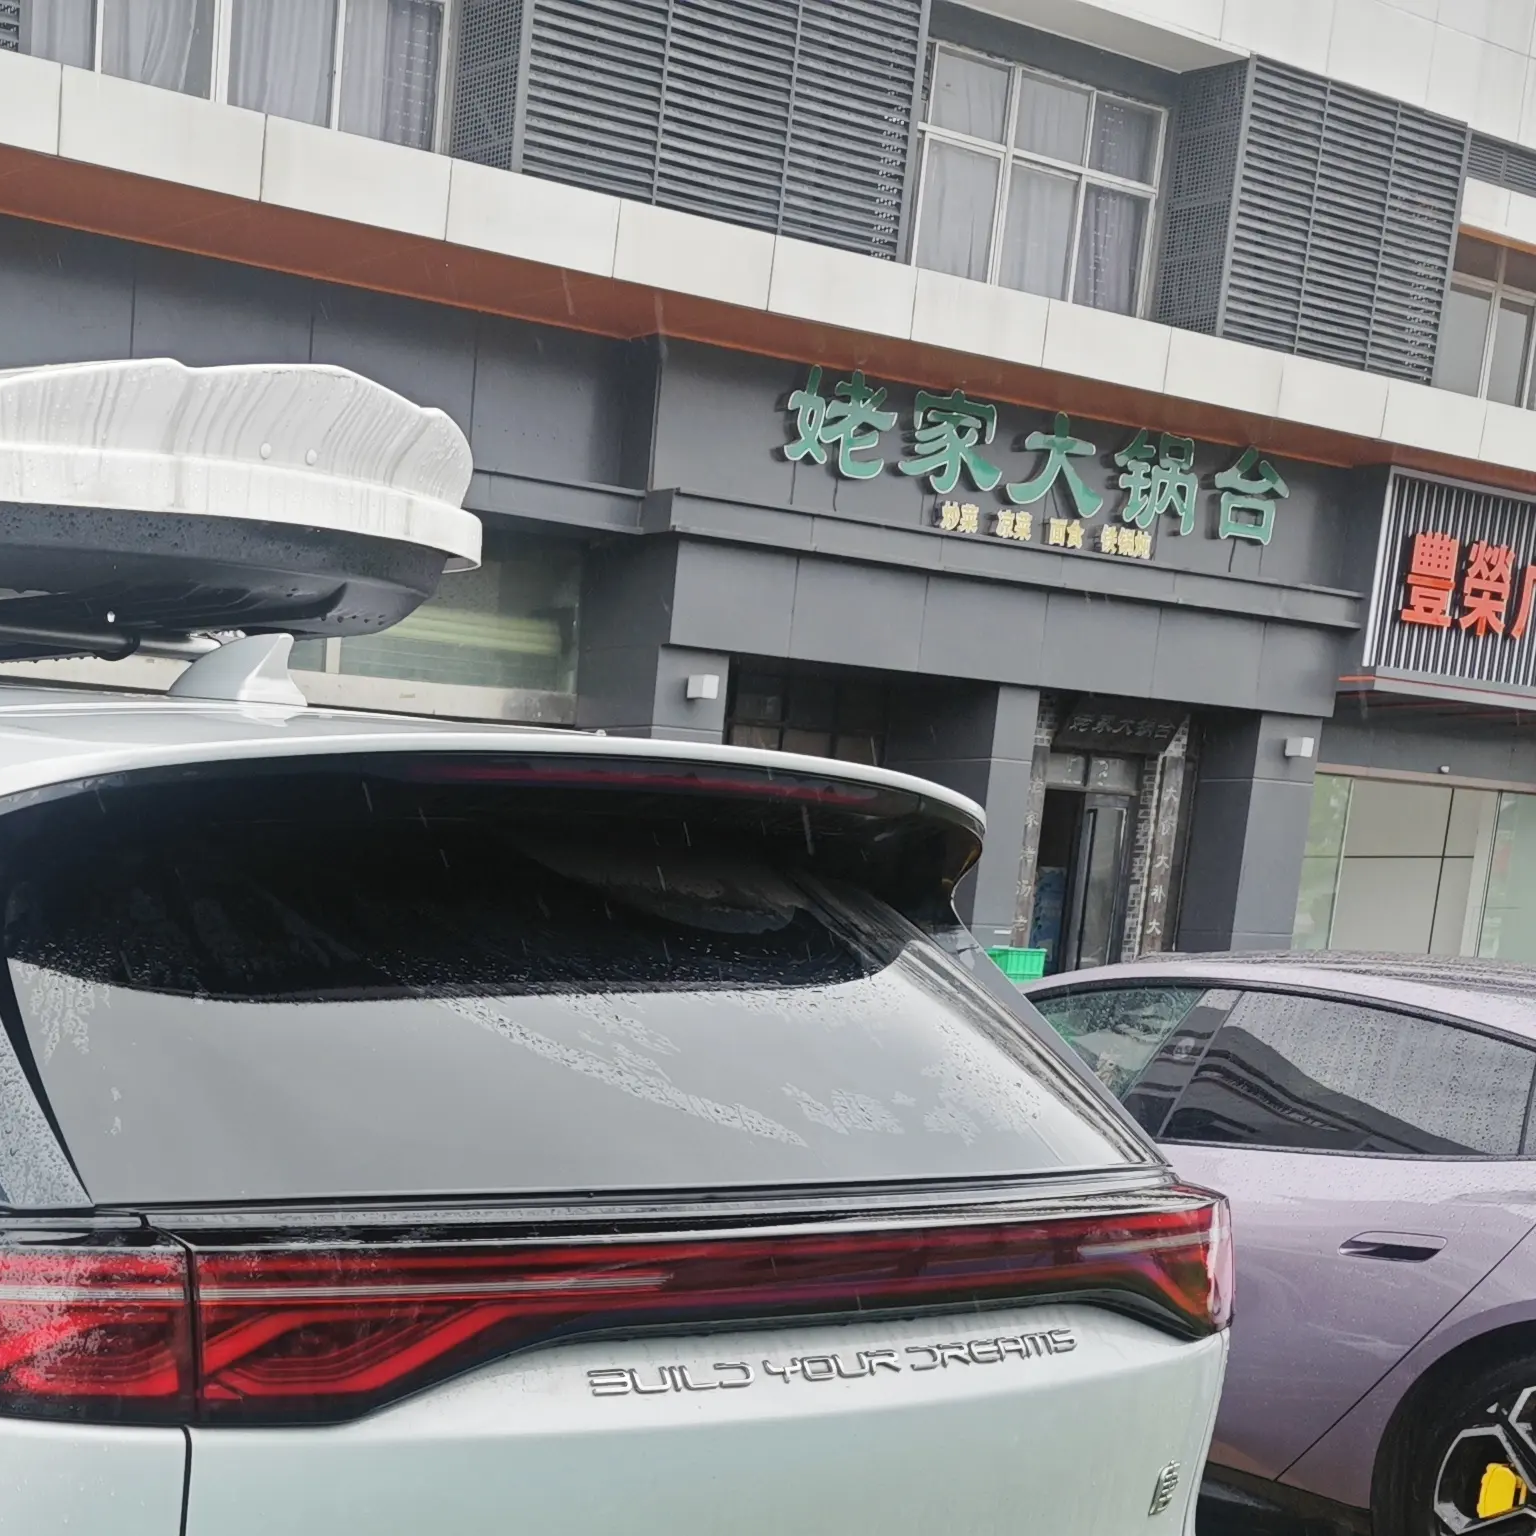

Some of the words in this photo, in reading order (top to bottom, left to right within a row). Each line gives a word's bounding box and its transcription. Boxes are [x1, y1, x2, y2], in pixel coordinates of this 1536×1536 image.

[783, 364, 1290, 546] 姥家大锅台
[1048, 517, 1085, 549] 面食
[587, 1361, 755, 1396] BUILD
[762, 1349, 902, 1384] YOUR
[905, 1328, 1078, 1372] DREAMS
